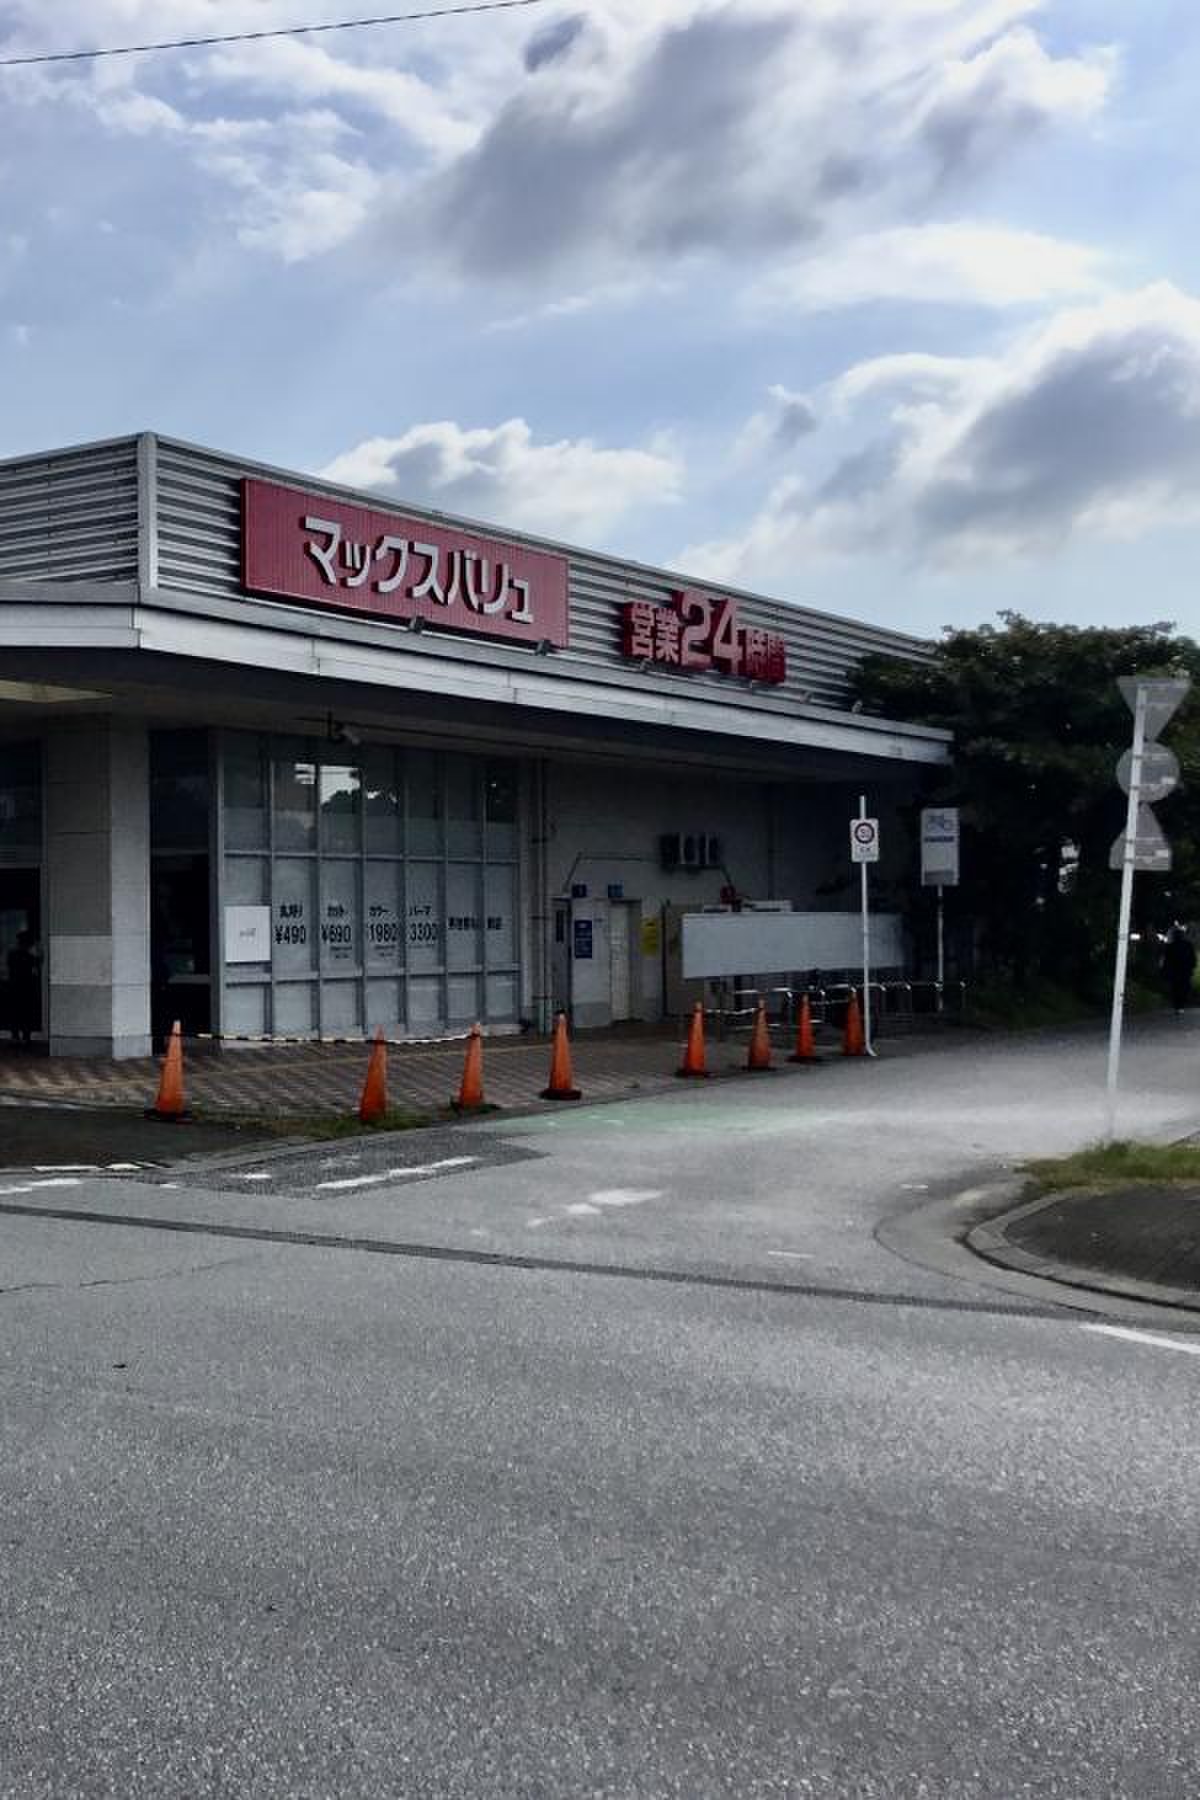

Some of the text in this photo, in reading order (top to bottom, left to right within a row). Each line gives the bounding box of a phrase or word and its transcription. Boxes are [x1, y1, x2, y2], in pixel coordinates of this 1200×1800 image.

[303, 516, 534, 623] マックスバリュ
[275, 924, 306, 944] ¥490
